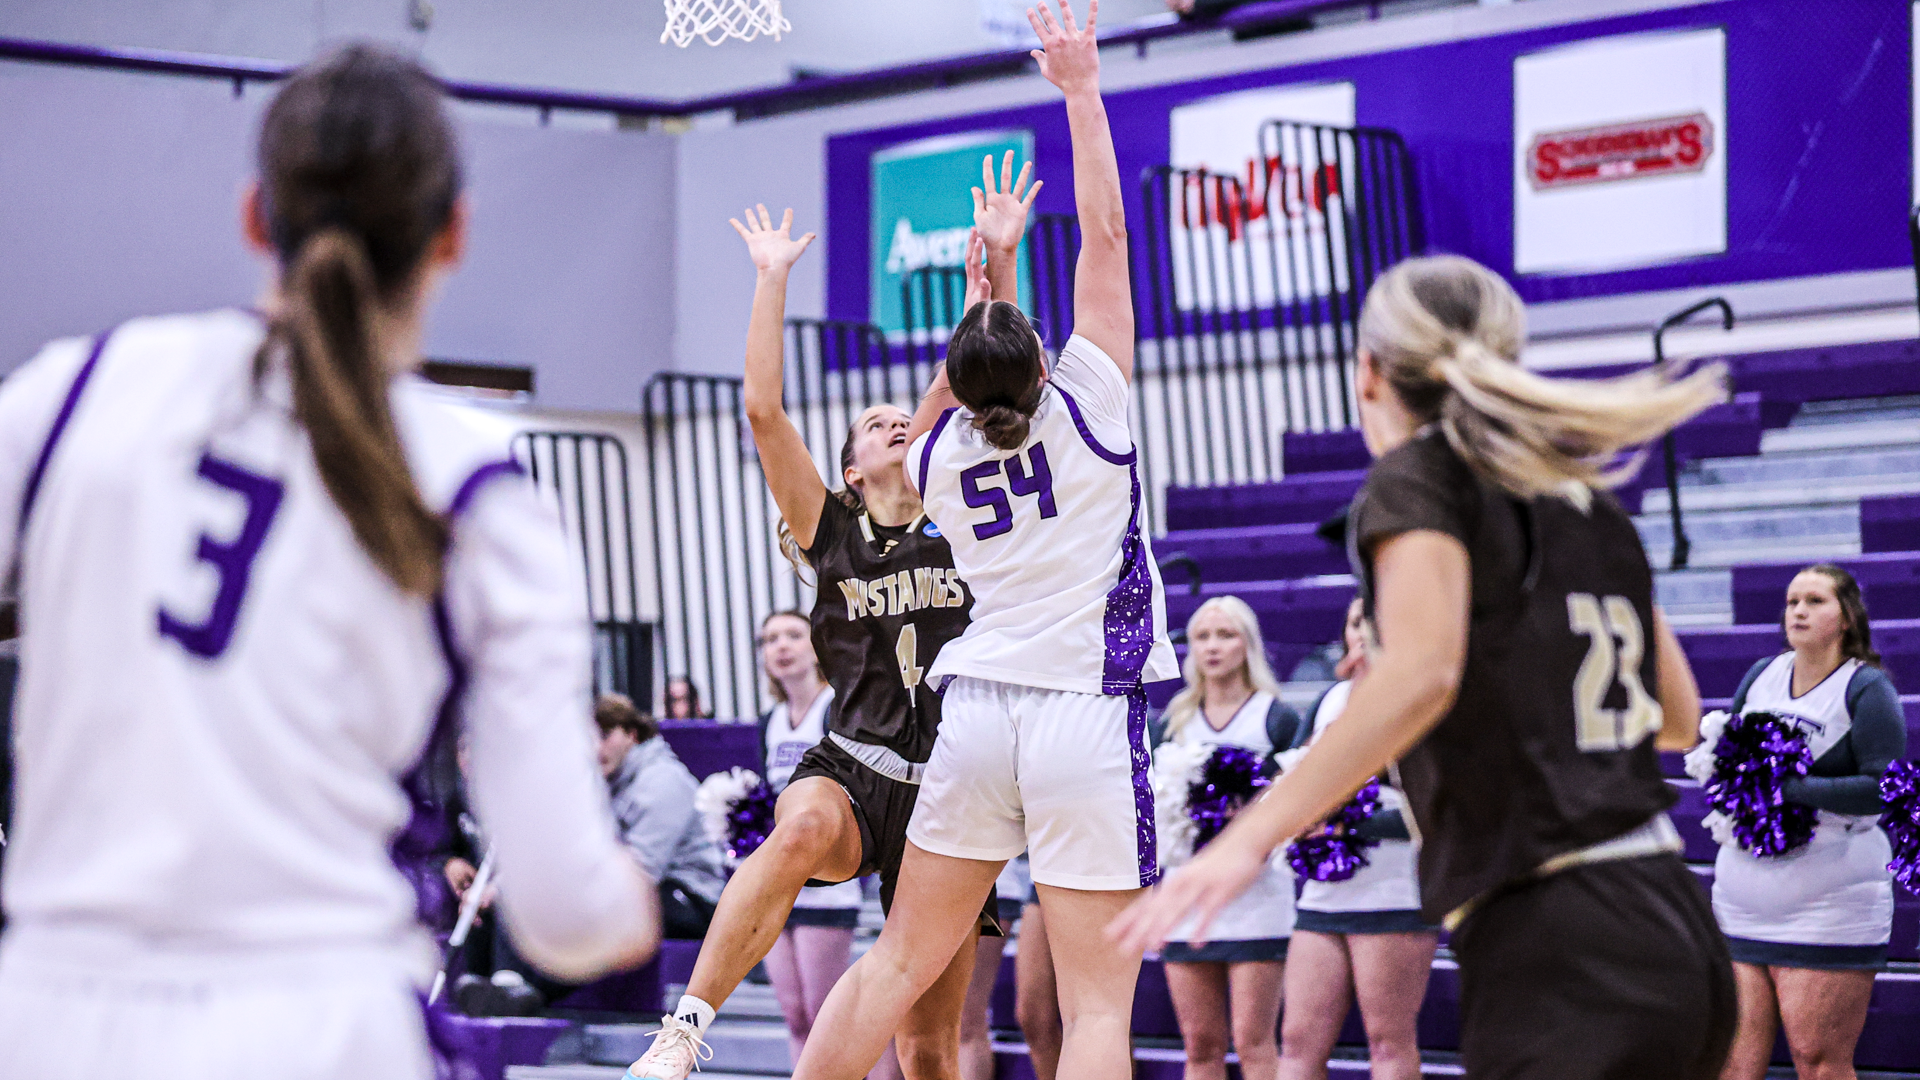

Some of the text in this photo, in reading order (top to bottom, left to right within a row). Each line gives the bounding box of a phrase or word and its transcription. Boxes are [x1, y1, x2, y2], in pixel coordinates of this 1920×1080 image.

[886, 217, 988, 274] Aver
[959, 440, 1058, 541] 54
[156, 452, 285, 659] 3
[895, 623, 924, 708] 4
[1566, 592, 1664, 753] 23
